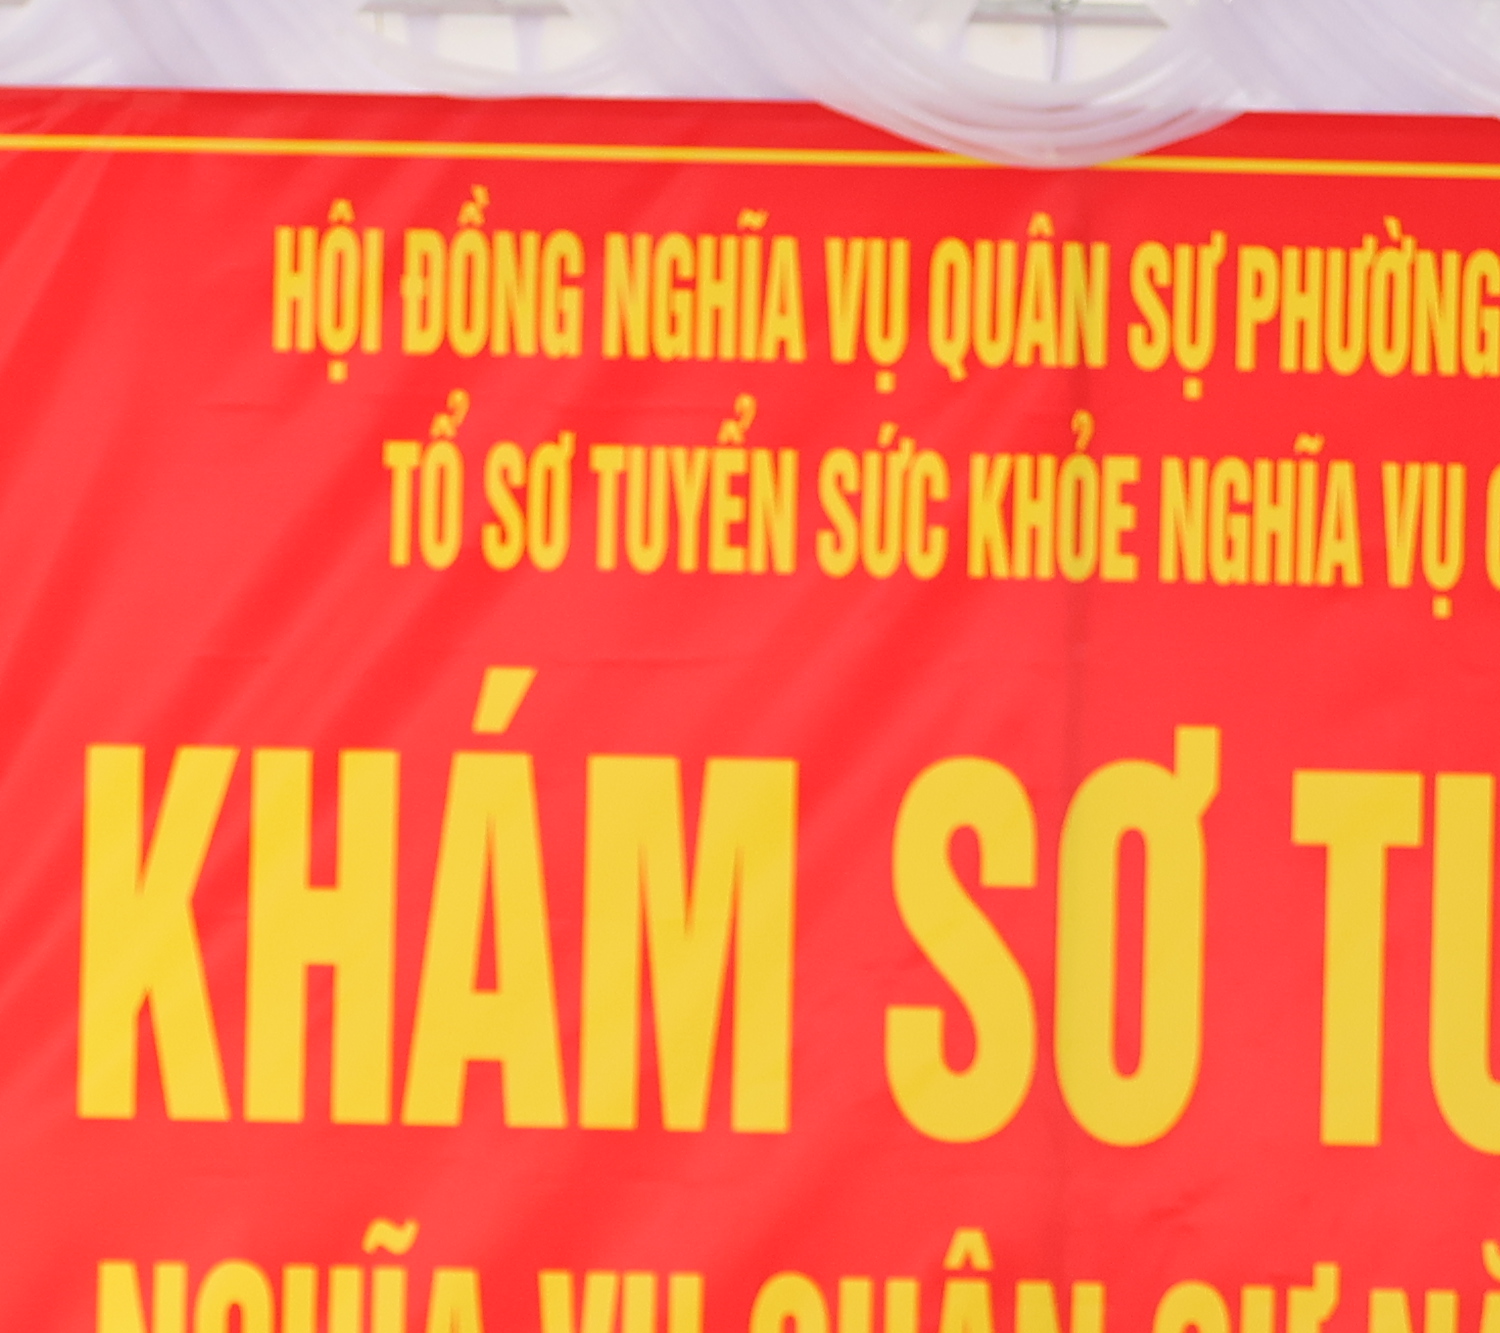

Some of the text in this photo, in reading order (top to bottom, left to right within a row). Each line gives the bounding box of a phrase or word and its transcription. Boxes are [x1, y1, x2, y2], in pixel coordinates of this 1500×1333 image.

[272, 199, 383, 382] HỘI
[401, 186, 583, 359] ĐỒNG
[602, 210, 806, 362] NGHĨA
[825, 237, 909, 393] VỤ
[929, 213, 1109, 380] QUÂN
[1128, 231, 1226, 399] SỰ
[383, 390, 469, 570] TỔ
[482, 431, 574, 571] SƠ
[590, 394, 797, 574] TUYỂN
[816, 423, 949, 579] SỨC
[968, 412, 1139, 581] KHỎE
[1159, 435, 1362, 586] NGHĨA
[1382, 462, 1465, 619] VỤ
[77, 666, 798, 1134] KHÁM
[885, 725, 1221, 1147] SƠ
